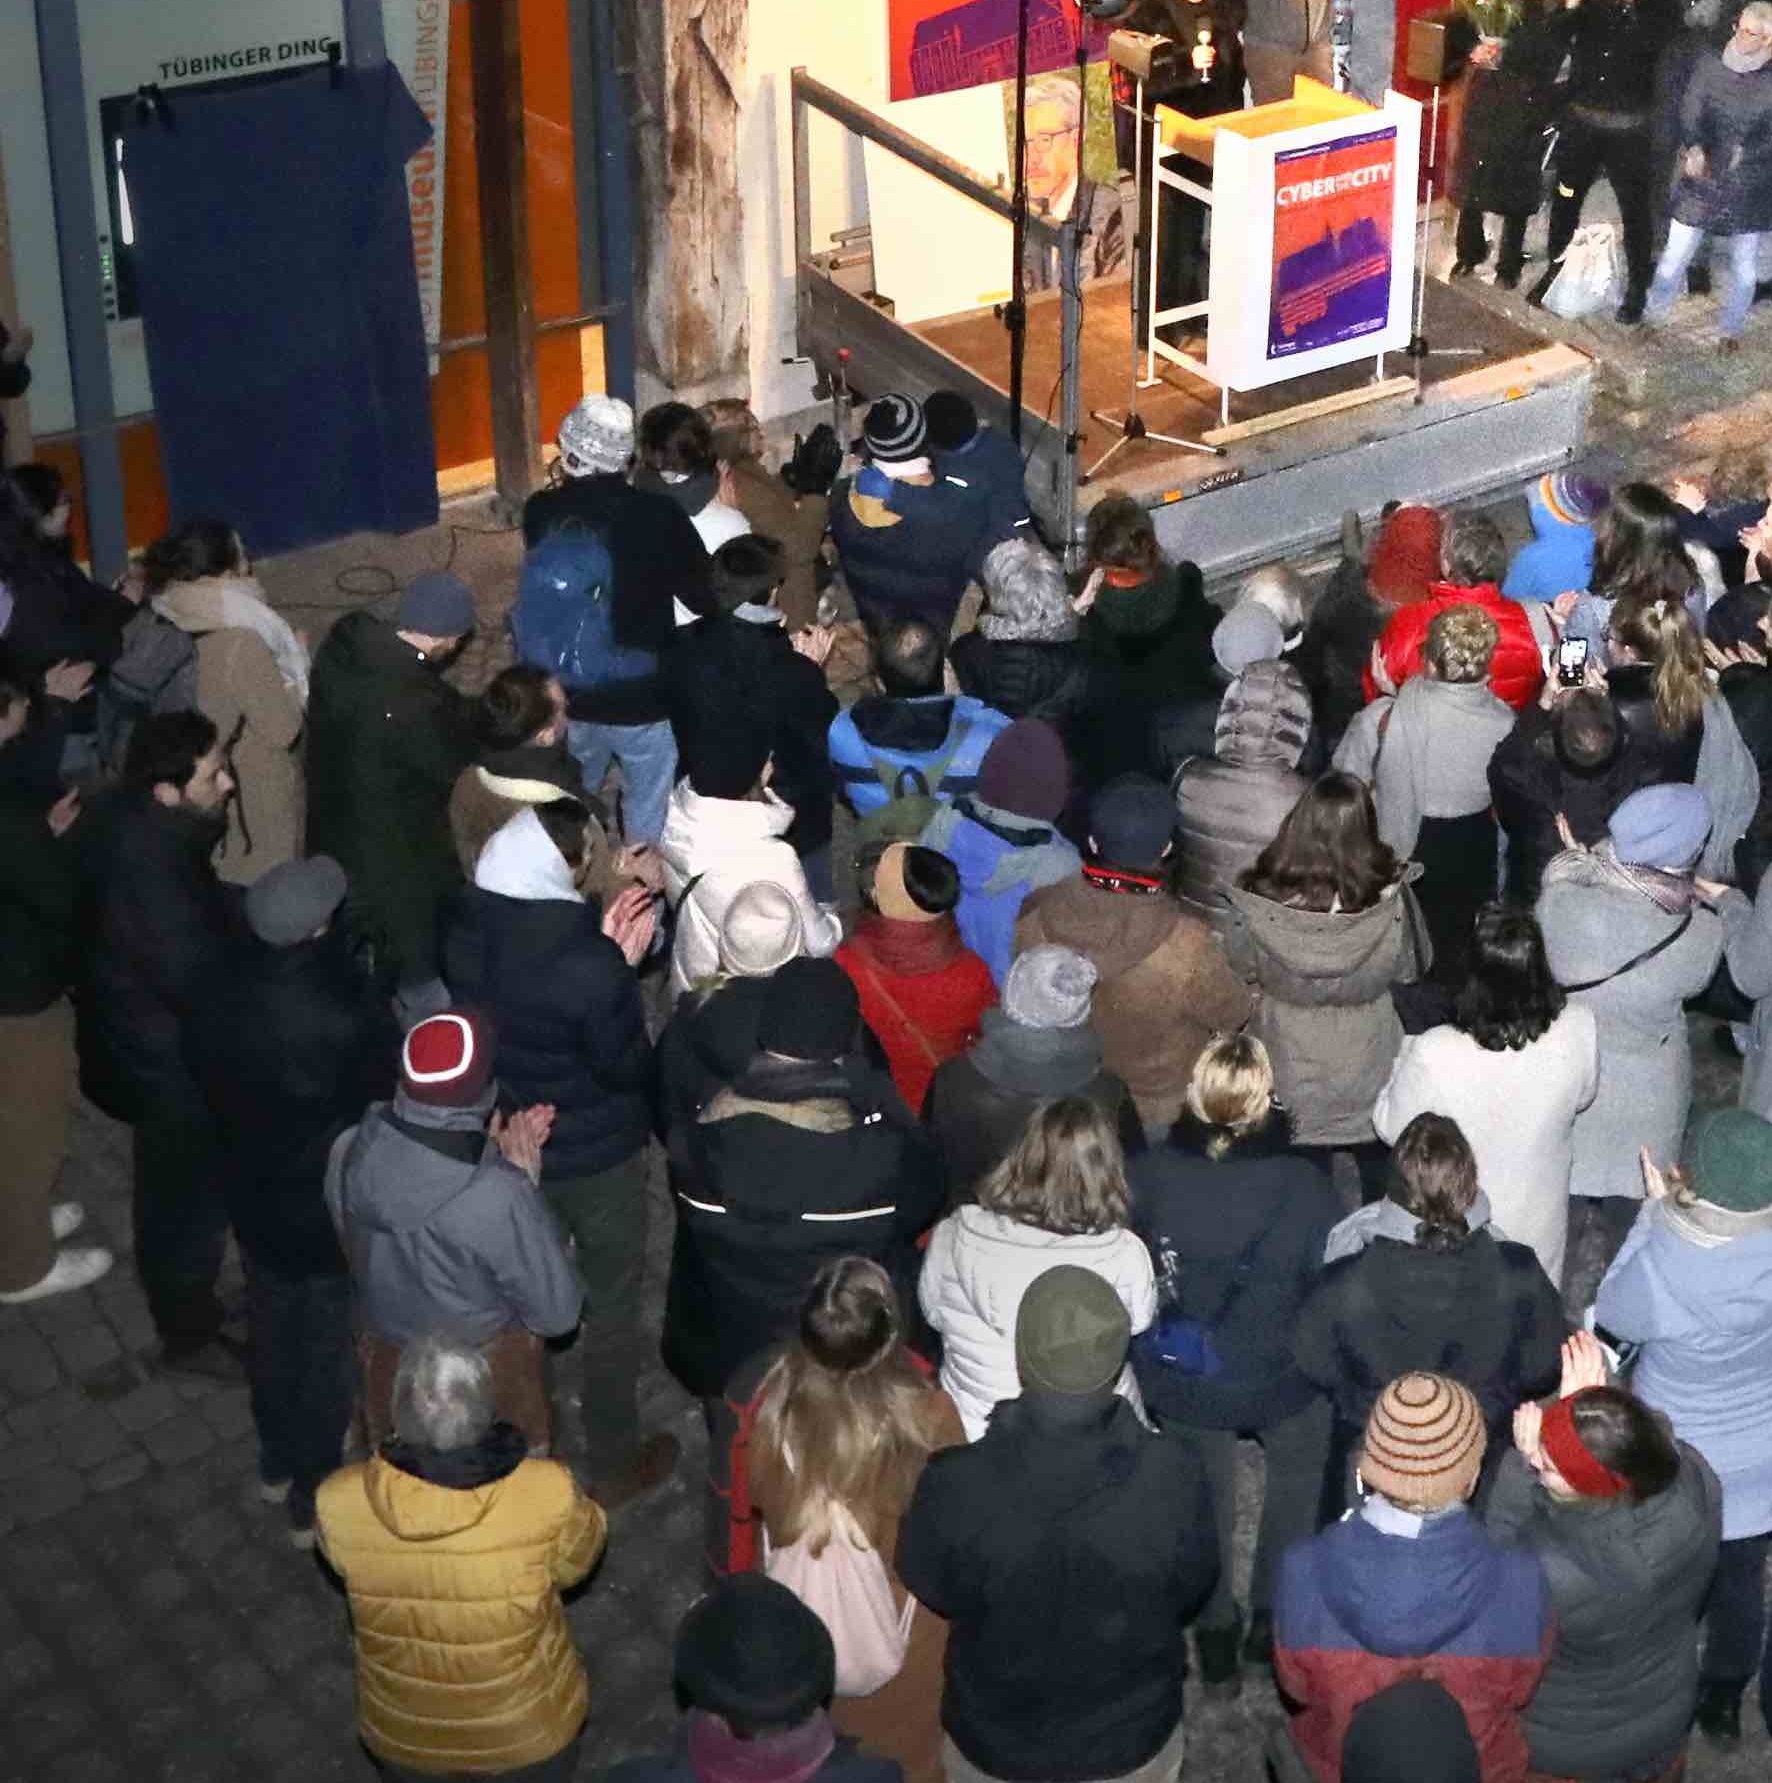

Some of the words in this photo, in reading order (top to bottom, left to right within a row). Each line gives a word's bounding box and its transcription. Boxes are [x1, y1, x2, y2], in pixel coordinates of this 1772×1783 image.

[159, 46, 271, 80] TÜBINGER
[1276, 176, 1335, 207] CYBER
[1353, 162, 1393, 187] CITY
